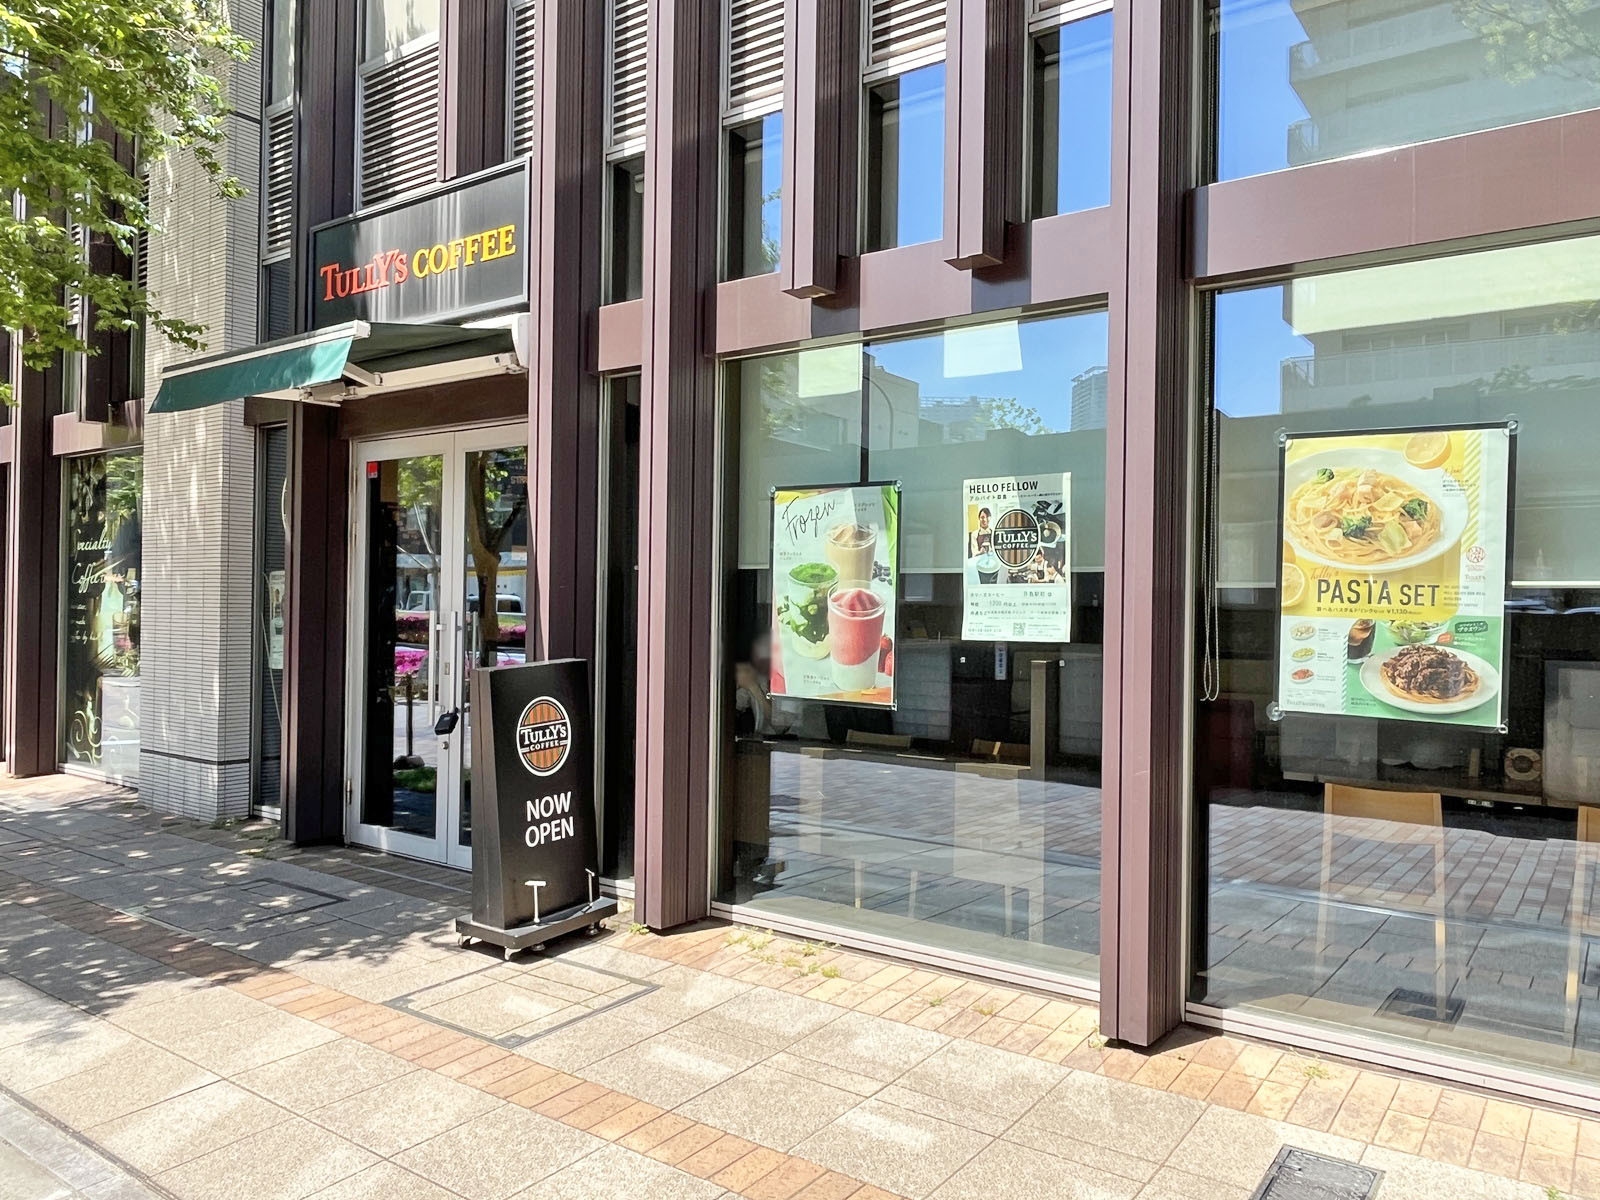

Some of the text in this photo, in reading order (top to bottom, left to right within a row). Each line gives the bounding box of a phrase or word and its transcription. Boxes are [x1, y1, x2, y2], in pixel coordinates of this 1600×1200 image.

[412, 224, 516, 279] COFFEE
[969, 481, 1038, 494] HELLO FELLOW
[782, 496, 836, 546] Frozen
[1317, 578, 1392, 605] PASTA
[1400, 584, 1440, 607] SET
[530, 740, 559, 751] COFFEE
[526, 791, 572, 822] NOW
[525, 816, 574, 848] OPEN
